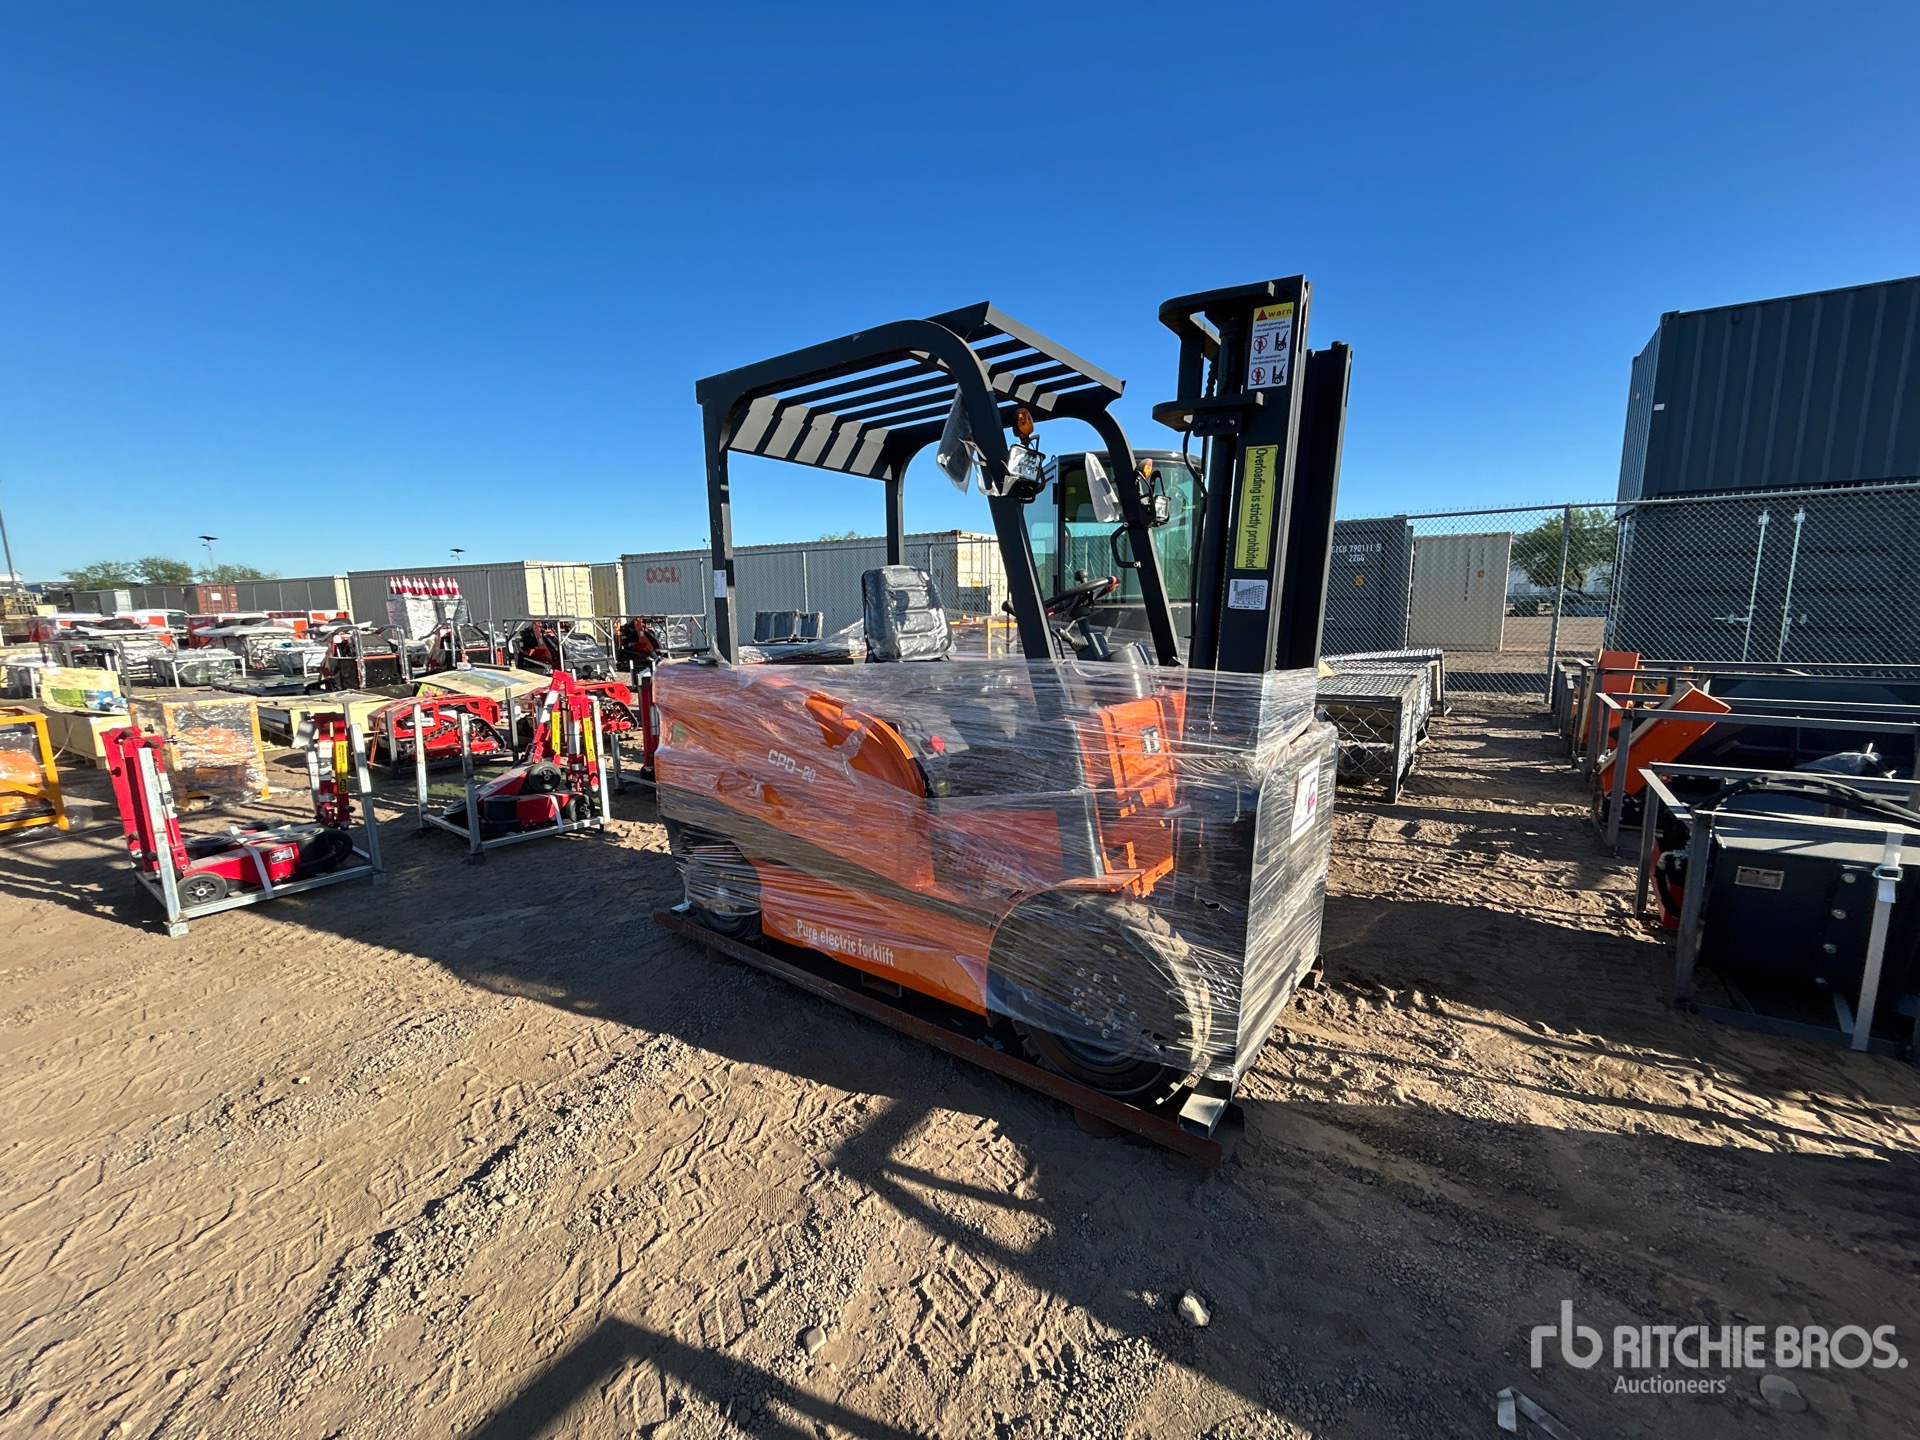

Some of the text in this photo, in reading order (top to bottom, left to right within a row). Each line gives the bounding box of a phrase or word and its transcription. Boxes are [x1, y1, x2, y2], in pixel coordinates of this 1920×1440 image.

[1268, 309, 1292, 317] warn
[1249, 448, 1268, 493] Overloading
[1246, 503, 1263, 529] strictly
[1245, 530, 1260, 568] prohibited
[768, 749, 816, 783] CPD-20
[796, 919, 895, 966] Pure electric forklift
